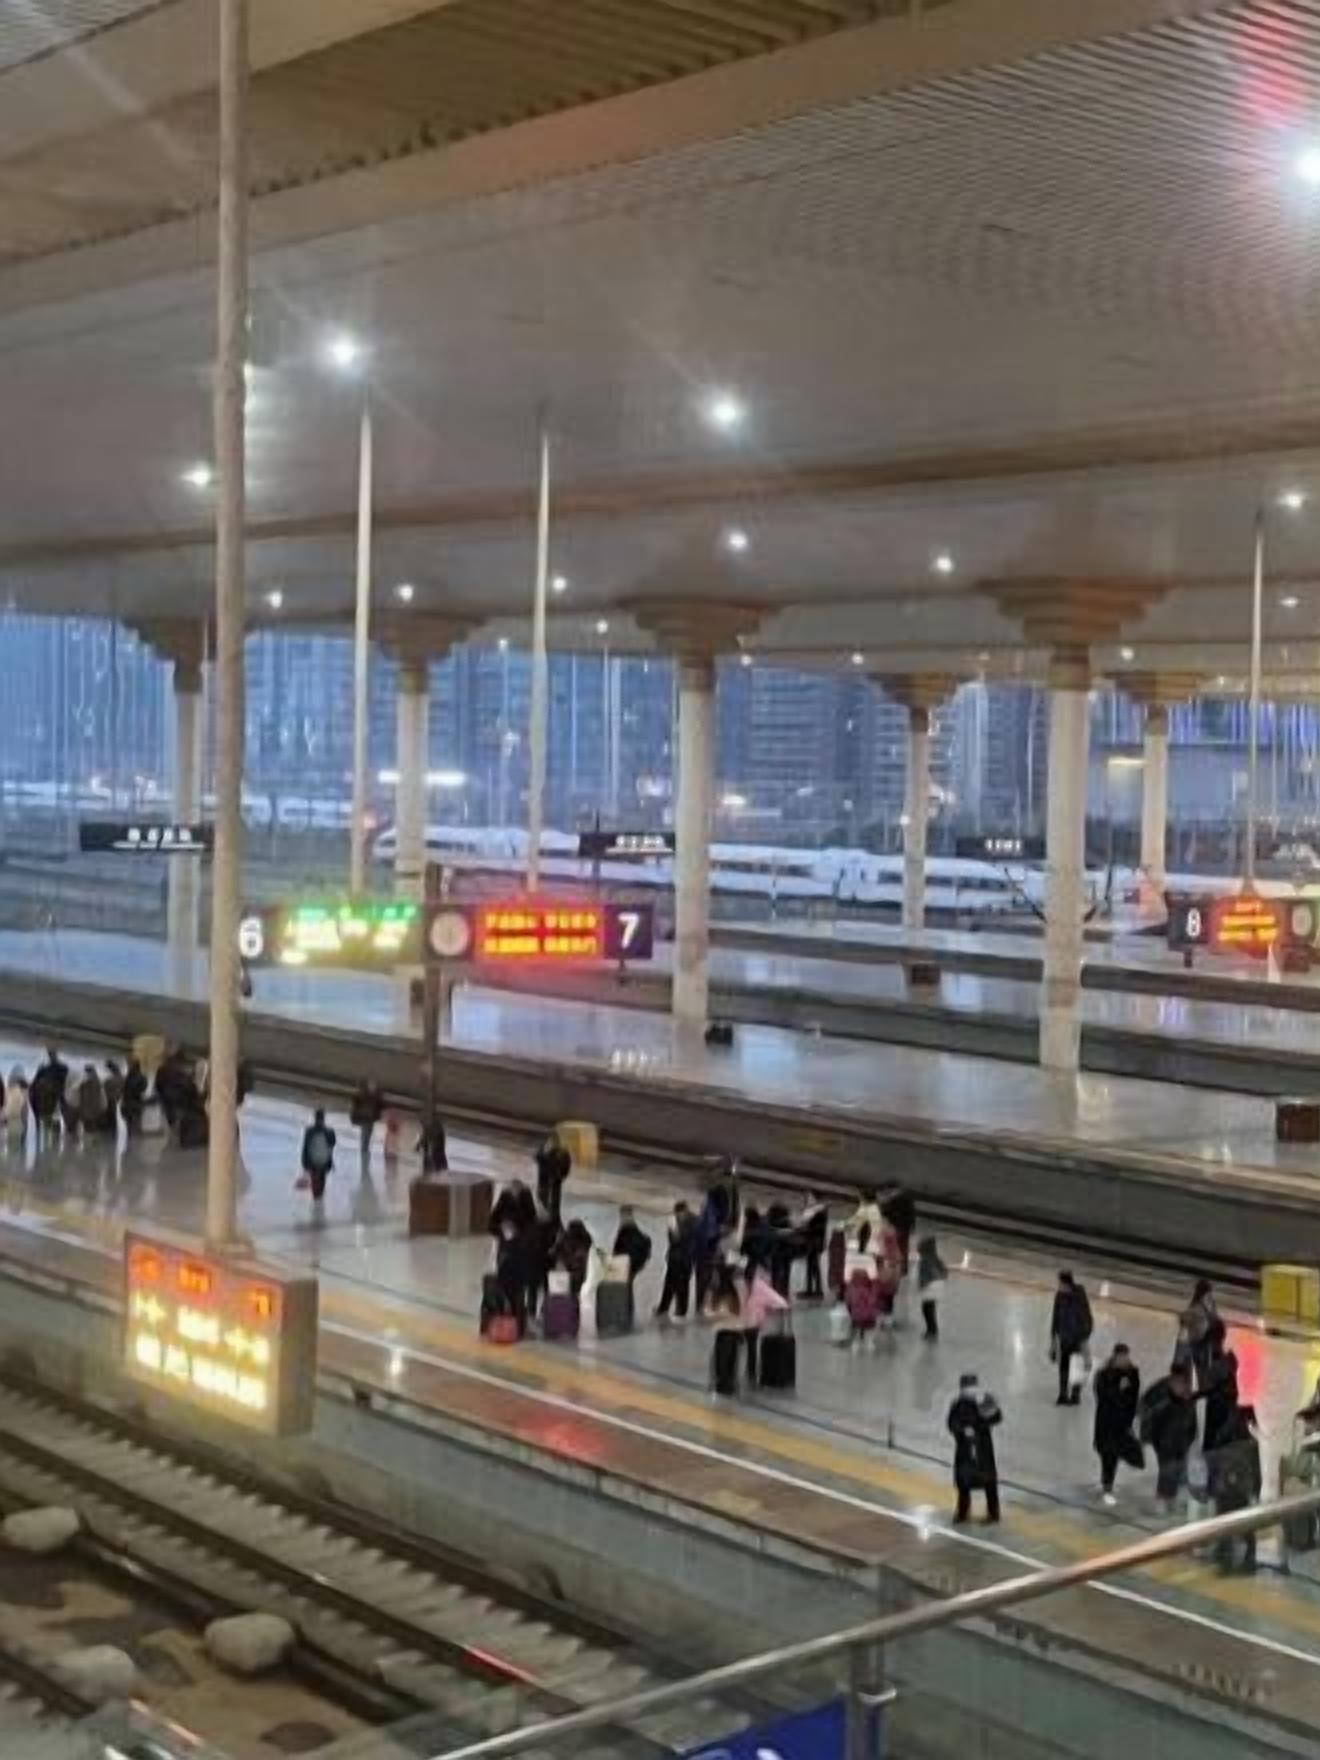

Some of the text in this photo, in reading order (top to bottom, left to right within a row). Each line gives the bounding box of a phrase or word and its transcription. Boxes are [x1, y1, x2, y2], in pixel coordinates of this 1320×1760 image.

[239, 916, 263, 957] 6
[617, 912, 640, 948] 7
[1187, 907, 1201, 937] 8
